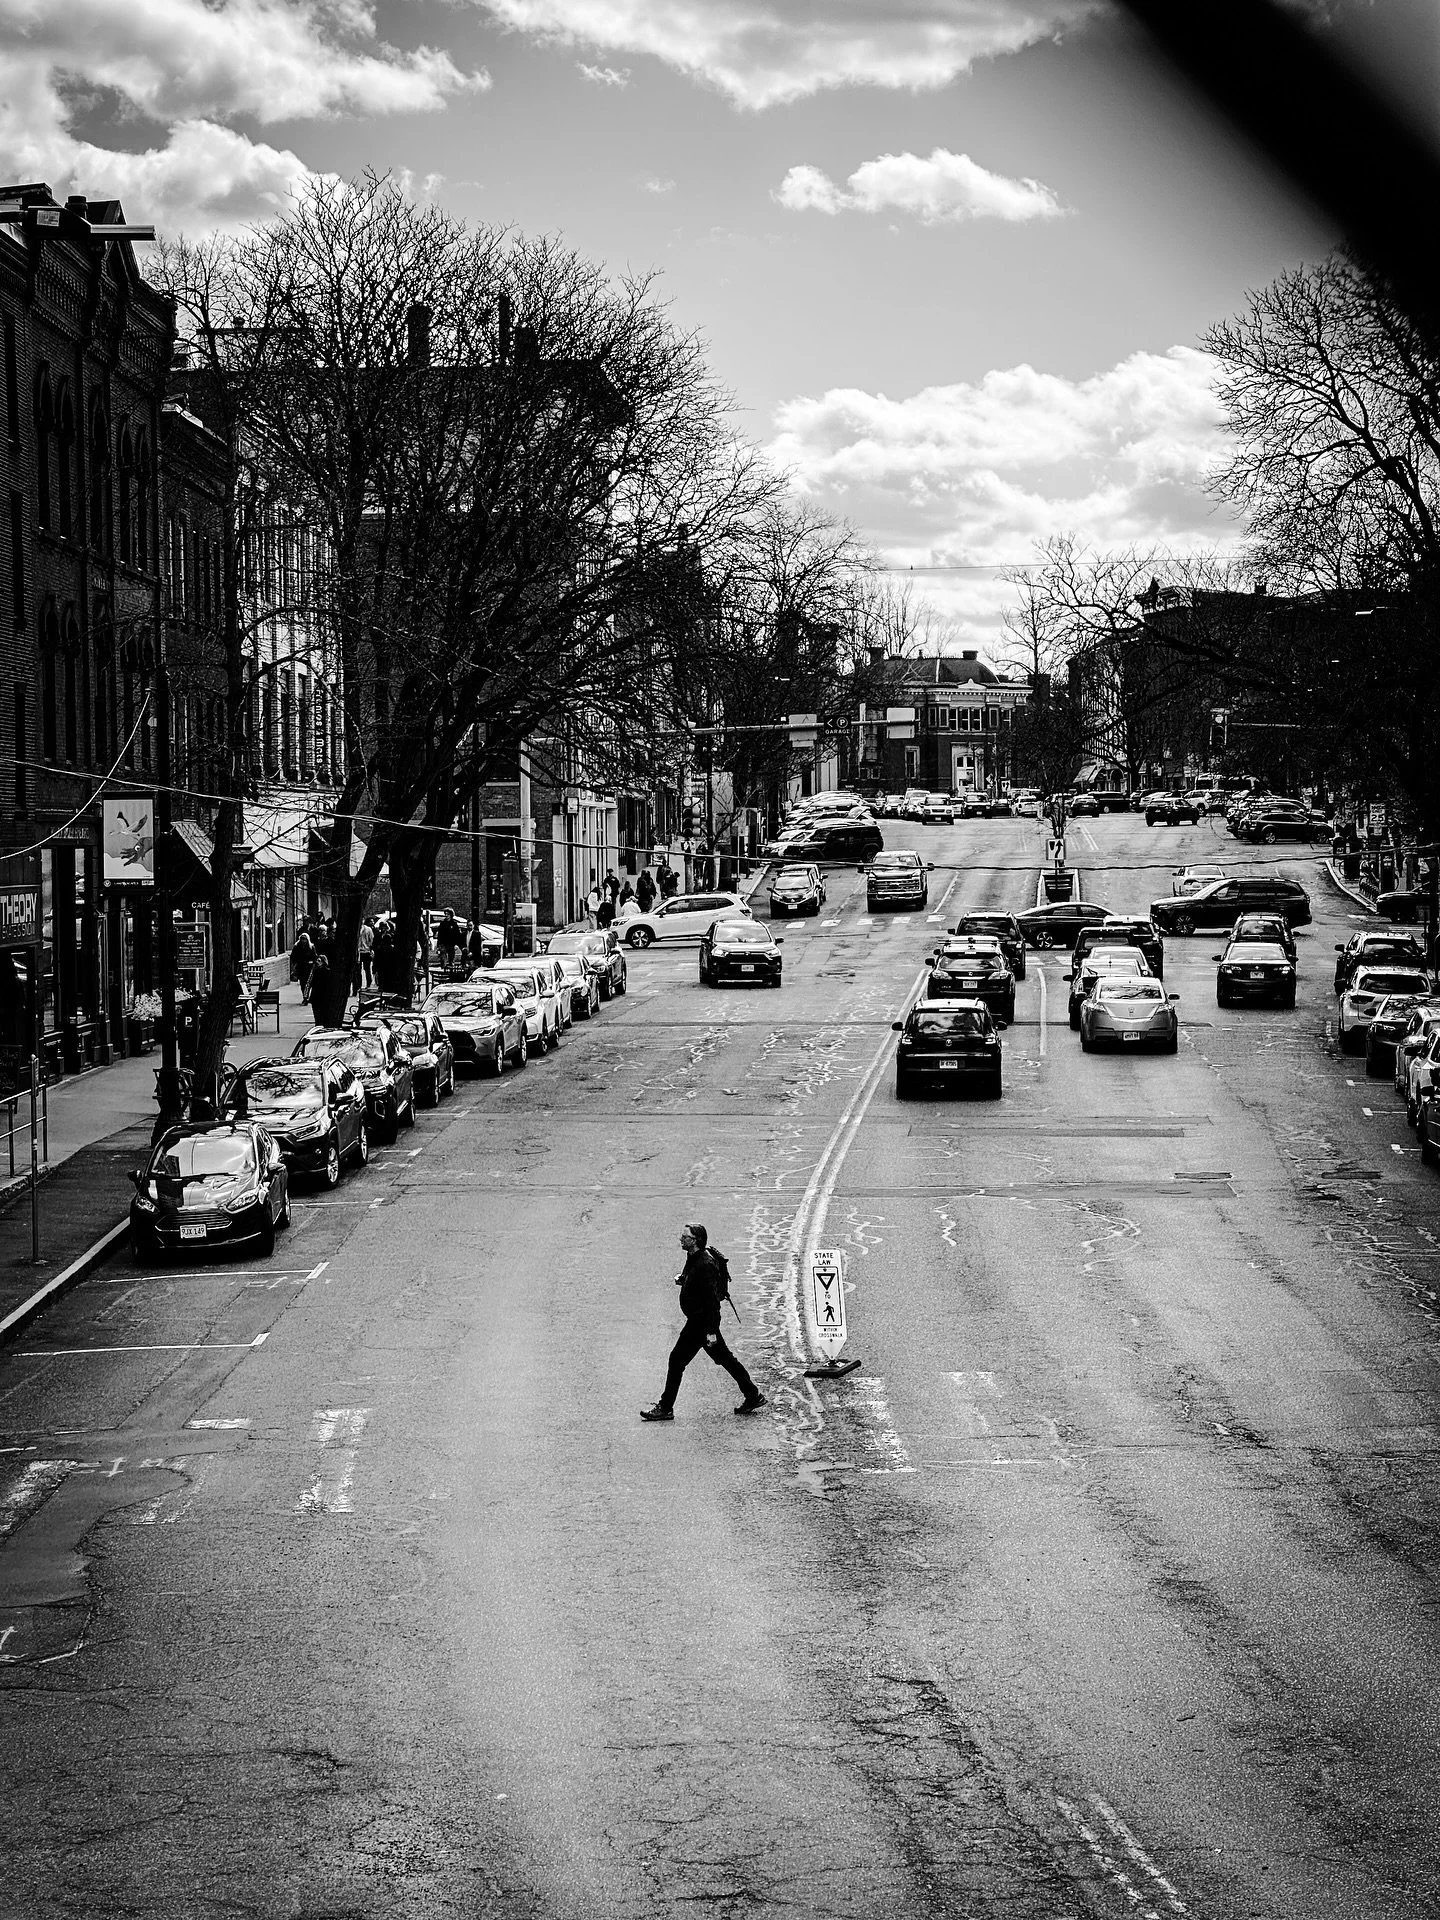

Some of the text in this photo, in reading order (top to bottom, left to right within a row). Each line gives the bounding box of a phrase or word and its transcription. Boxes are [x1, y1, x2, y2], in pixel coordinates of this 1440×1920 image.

[1371, 813, 1385, 822] 25
[0, 892, 38, 926] THEORY
[191, 901, 211, 909] CAFÉ
[185, 1016, 193, 1026] P
